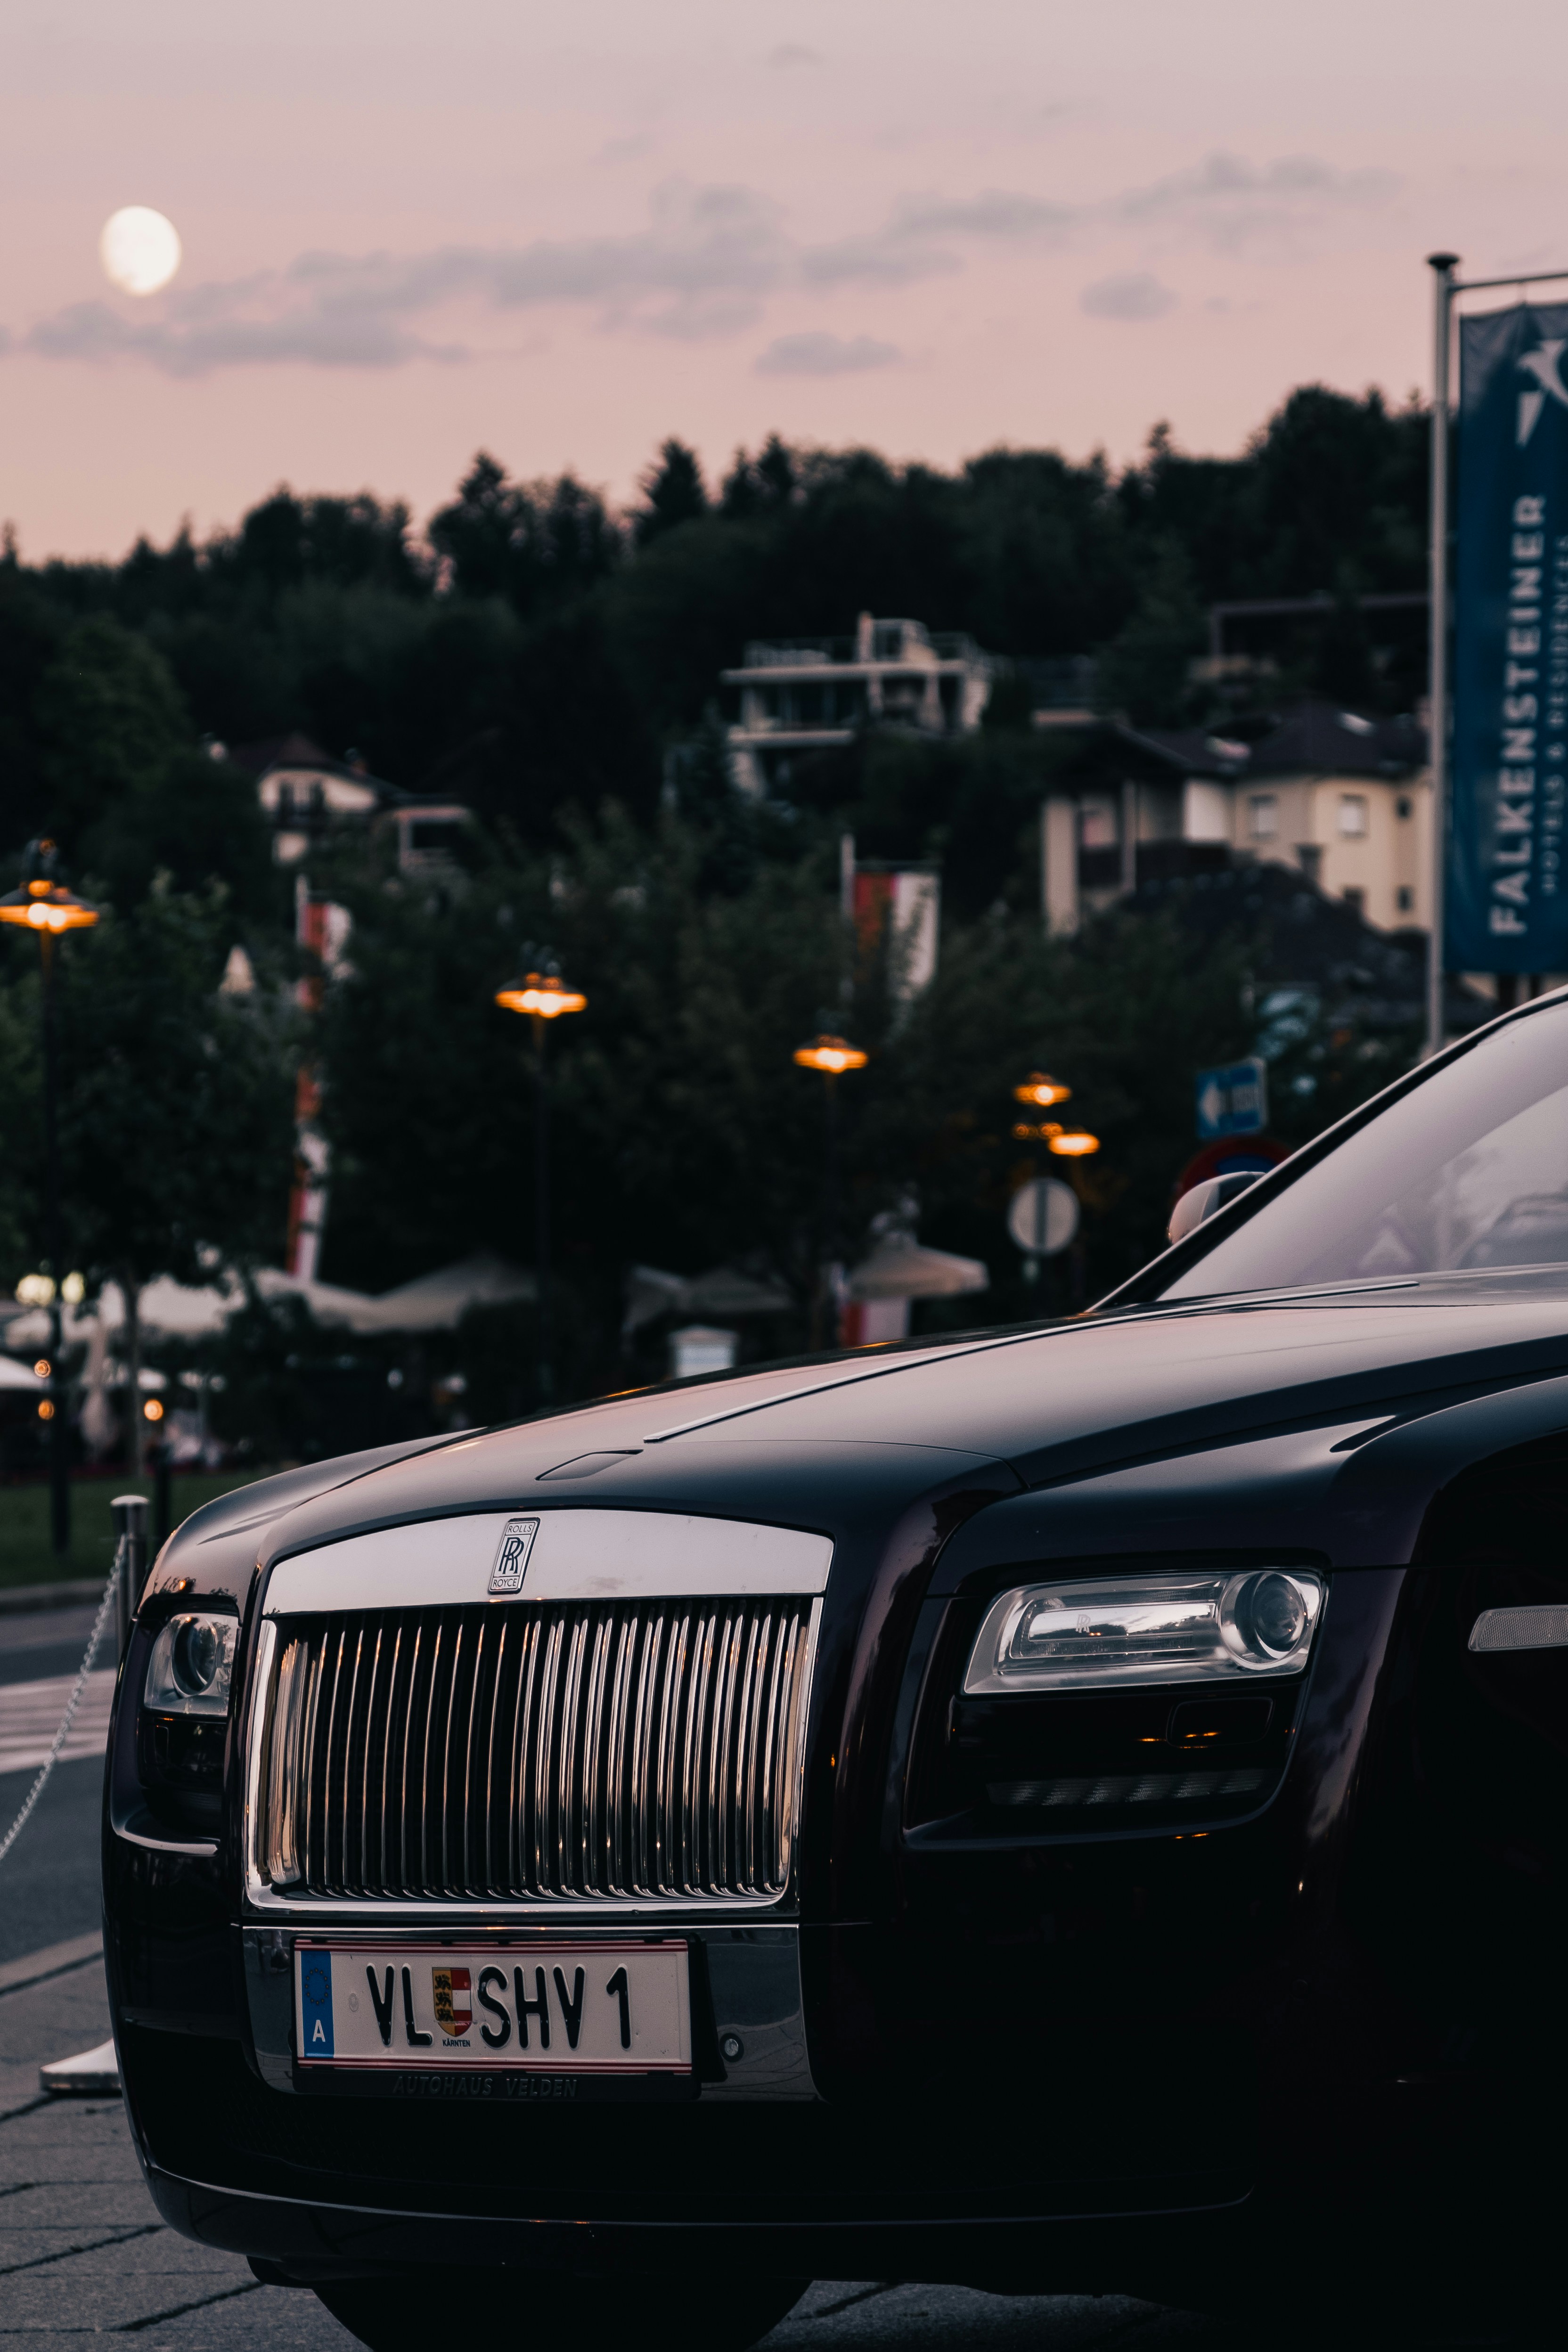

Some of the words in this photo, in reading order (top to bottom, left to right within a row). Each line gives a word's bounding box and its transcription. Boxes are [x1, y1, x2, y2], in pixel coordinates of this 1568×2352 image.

[1488, 494, 1546, 936] FALKENSTEINER
[508, 1525, 532, 1533] ROLLS
[493, 1578, 517, 1587] ROYCE
[366, 1966, 433, 2046] VL
[477, 1966, 585, 2049] SHV
[606, 1967, 631, 2049] 1
[312, 2019, 326, 2042] A
[442, 2038, 470, 2047] KÄRNTEN
[392, 2076, 494, 2096] AUTOHAUS
[506, 2077, 577, 2097] VELDEN
